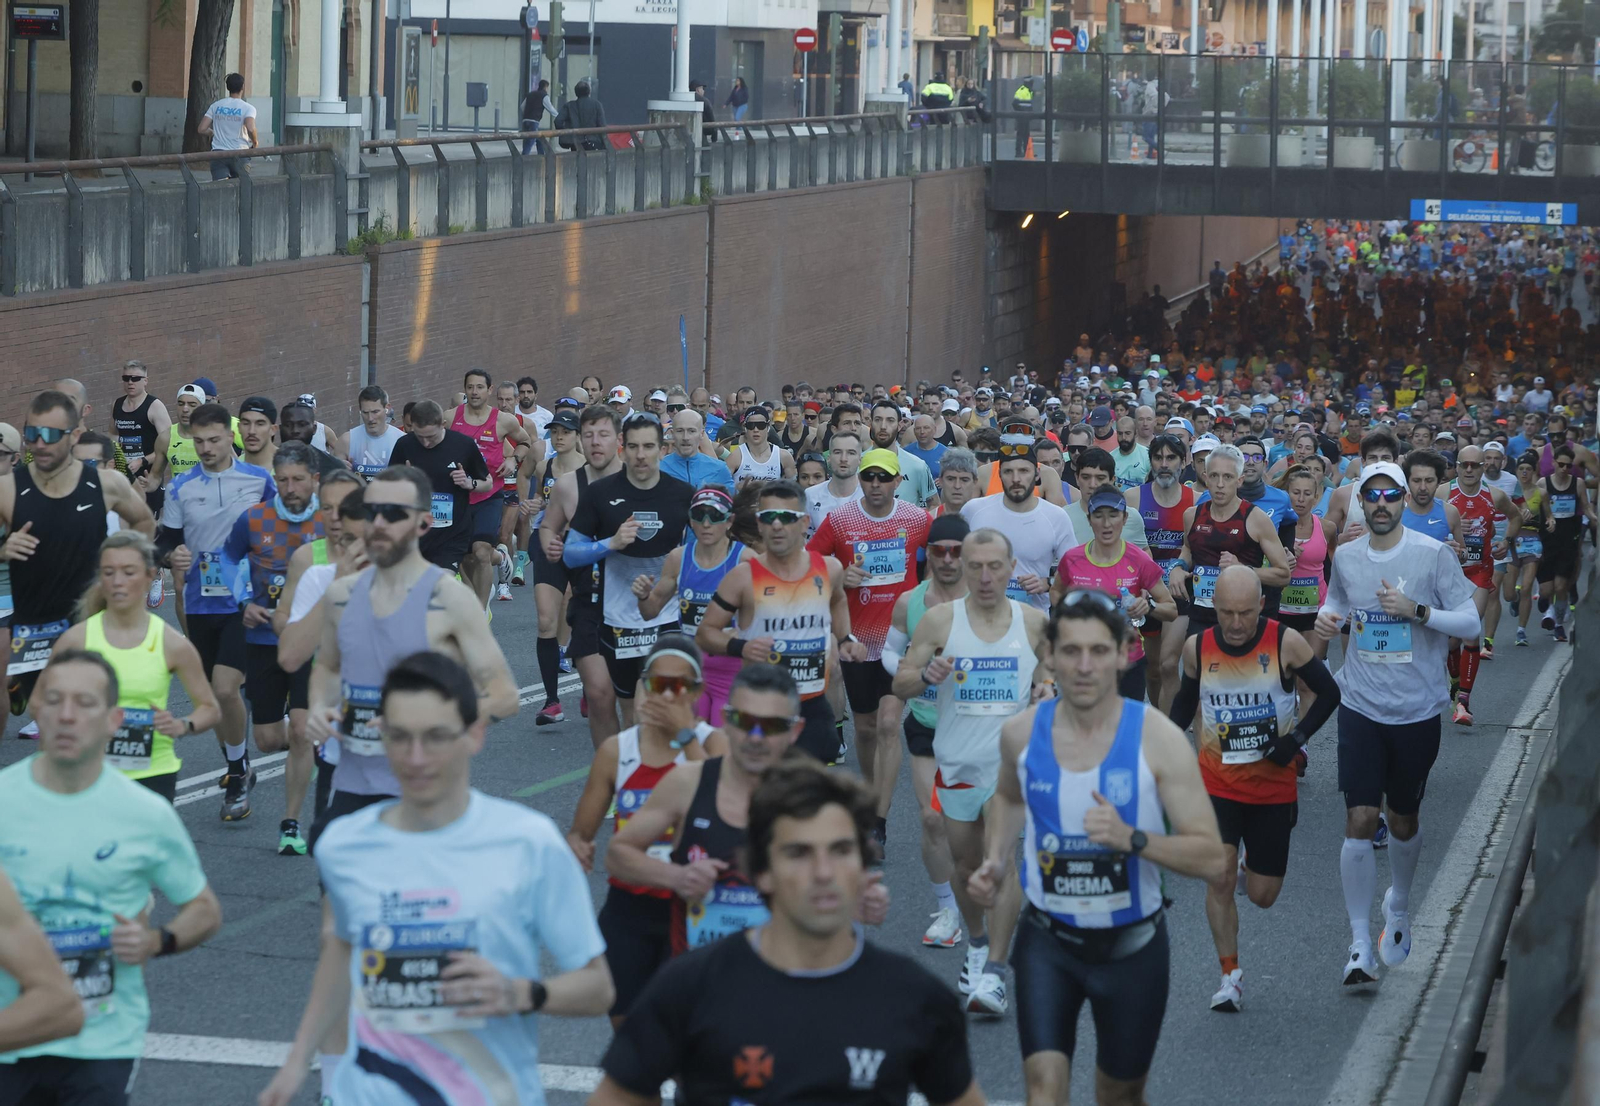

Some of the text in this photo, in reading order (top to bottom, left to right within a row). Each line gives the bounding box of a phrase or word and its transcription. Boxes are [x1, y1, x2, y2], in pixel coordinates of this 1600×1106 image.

[215, 106, 242, 116] HOKA
[871, 541, 899, 550] ZURICH
[869, 564, 894, 574] PENA
[1287, 597, 1310, 605] DIKLA
[1372, 629, 1389, 637] 4599
[790, 641, 821, 651] ZURICH
[1375, 640, 1388, 651] JP
[23, 648, 52, 661] HUGO
[790, 658, 809, 666] 3772
[977, 660, 1011, 669] ZURICH
[788, 667, 819, 680] ANJE
[978, 677, 996, 686] 7734
[960, 689, 1014, 700] BECERRA
[1236, 707, 1269, 719] ZURICH
[113, 740, 146, 756] FAFA
[1054, 876, 1113, 895] CHEMA
[845, 1046, 886, 1081] W
